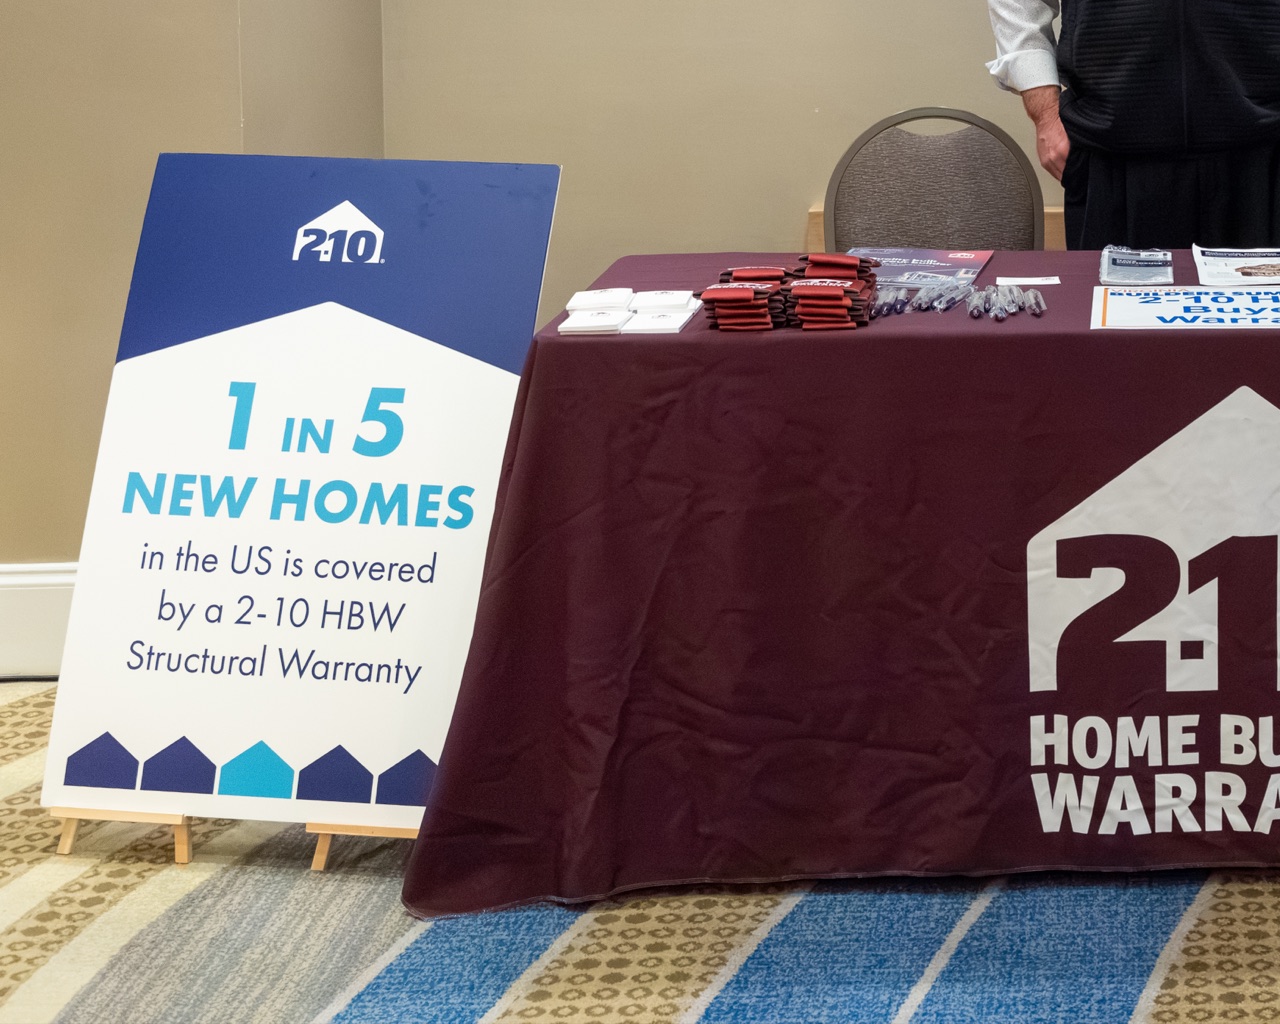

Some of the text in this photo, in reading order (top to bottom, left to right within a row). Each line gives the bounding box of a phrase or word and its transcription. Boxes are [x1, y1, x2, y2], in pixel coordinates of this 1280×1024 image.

[1138, 295, 1235, 304] 2-10
[228, 381, 406, 458] 1 IN 5
[121, 471, 476, 530] NEW HOMES
[140, 540, 438, 584] in the US is covered
[157, 588, 407, 633] by a 2-10 HBW
[126, 639, 423, 695] Structural Warranty
[1029, 713, 1201, 770] HOME
